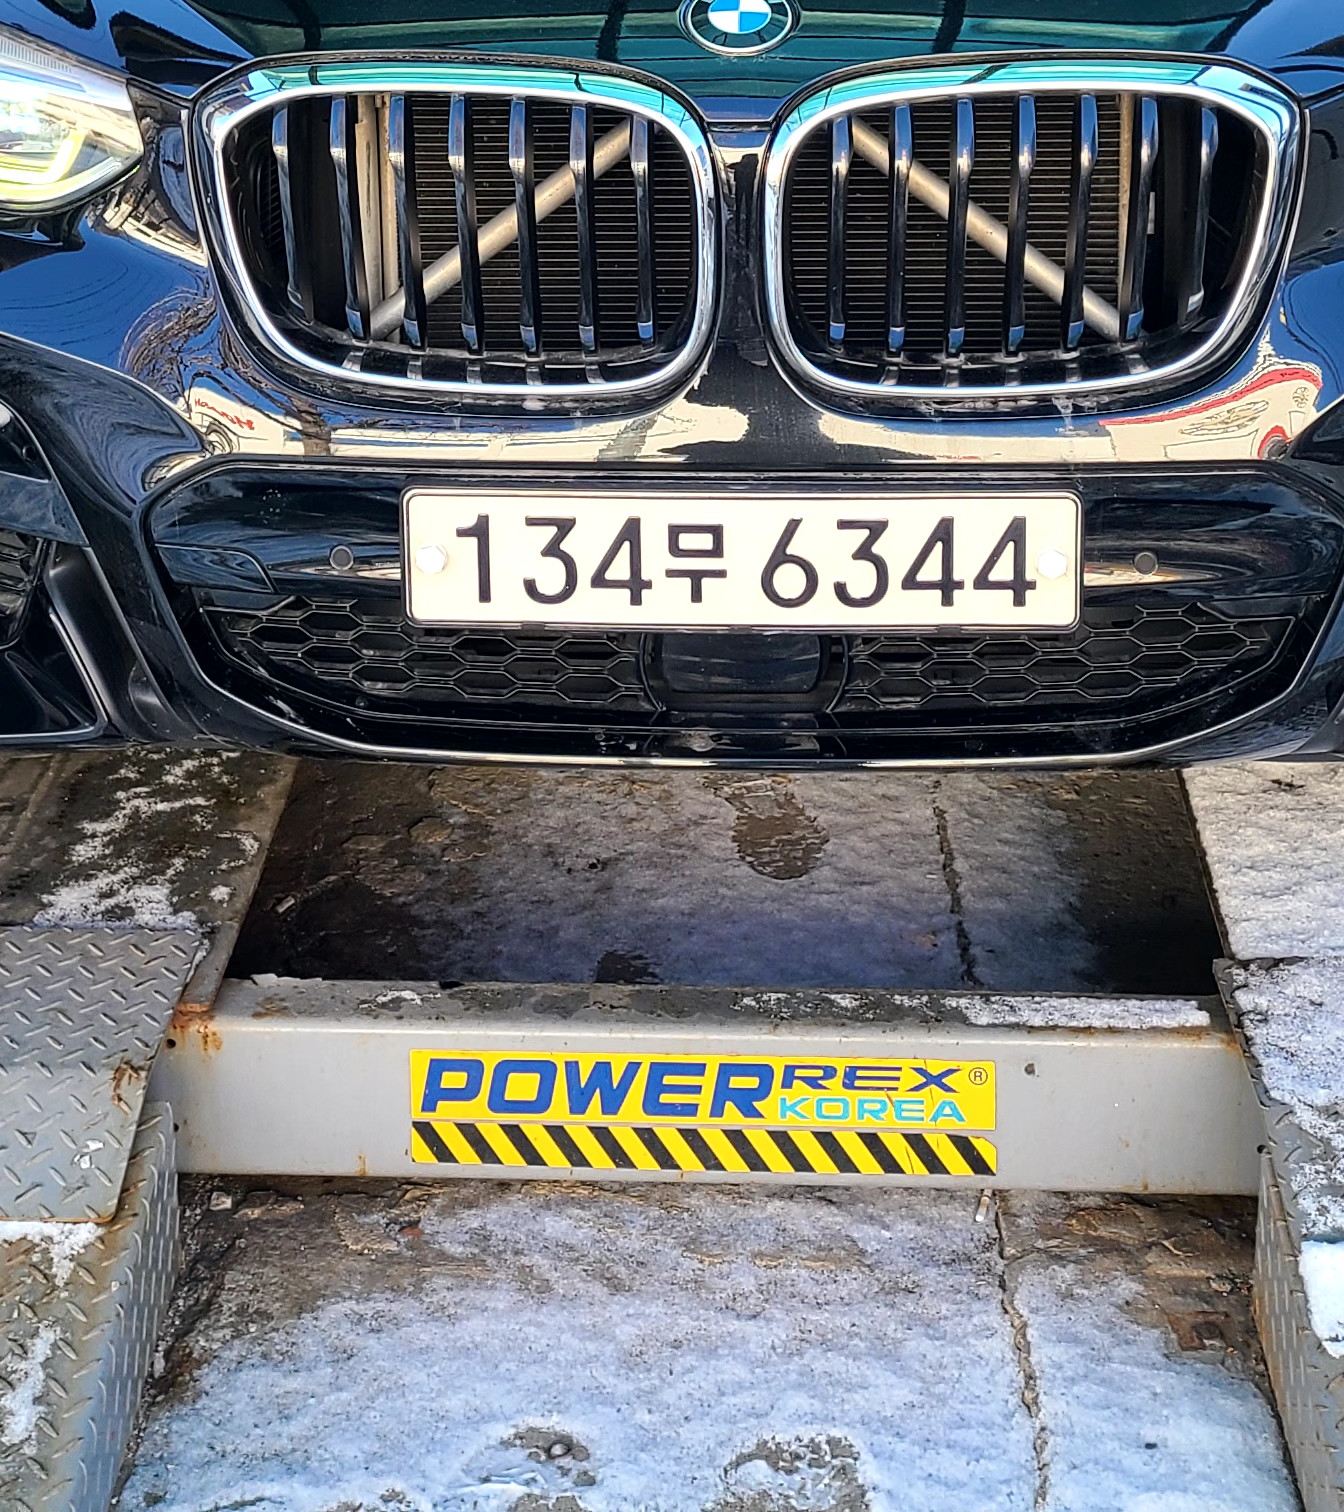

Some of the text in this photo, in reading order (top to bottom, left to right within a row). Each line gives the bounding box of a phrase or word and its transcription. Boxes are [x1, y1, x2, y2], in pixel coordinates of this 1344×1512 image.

[455, 513, 1037, 608] 134무 6344
[778, 1096, 967, 1124] KOREA
